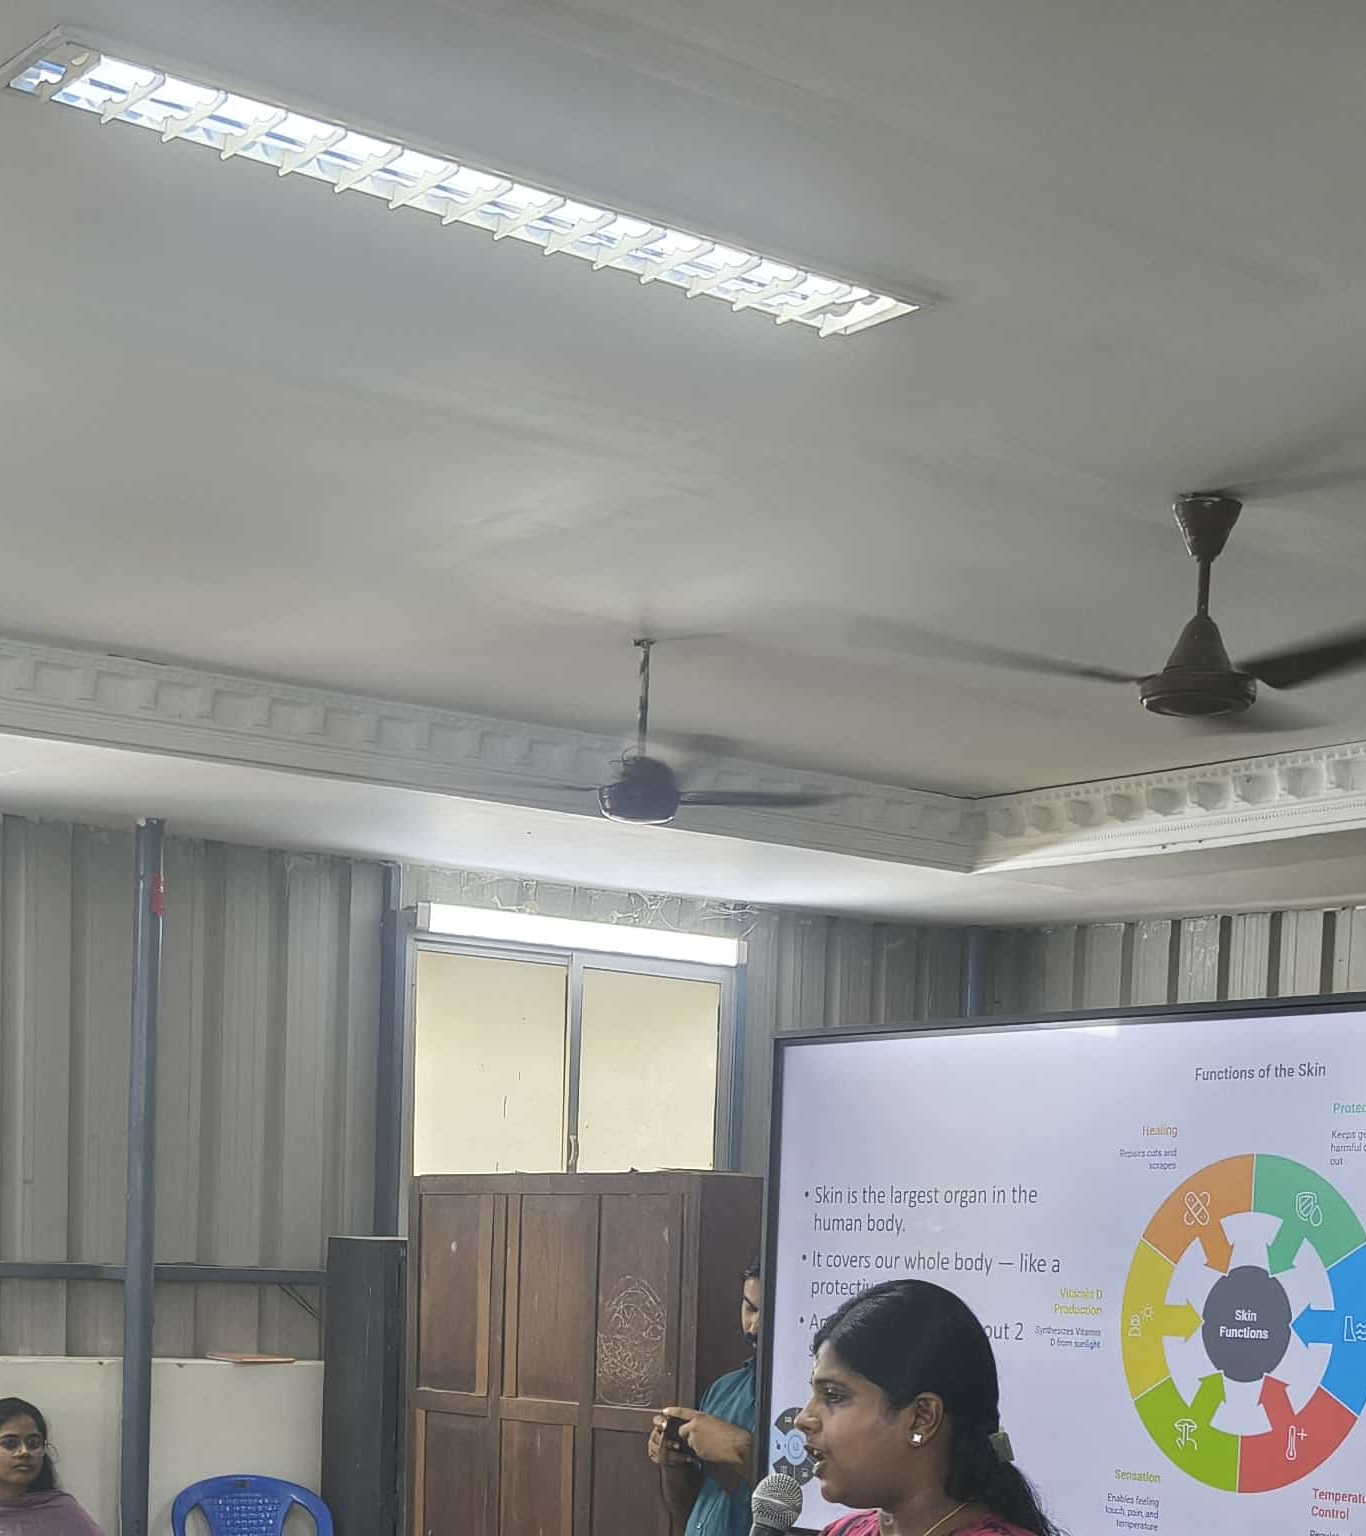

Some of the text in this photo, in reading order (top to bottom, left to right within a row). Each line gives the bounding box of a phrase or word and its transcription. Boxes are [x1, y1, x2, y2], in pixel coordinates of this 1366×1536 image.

[1194, 1061, 1326, 1080] Functions of the Skin
[1142, 1125, 1178, 1138] Healing
[1331, 1130, 1356, 1141] Keeps
[1163, 1148, 1178, 1157] and
[1330, 1143, 1362, 1153] harmful
[1330, 1158, 1344, 1166] out
[815, 1183, 1038, 1208] Skin is the largest organ in the
[814, 1212, 906, 1236] human body.
[812, 1249, 822, 1268] It
[826, 1253, 871, 1269] covers
[875, 1255, 900, 1270] our
[904, 1249, 950, 1271] whole
[954, 1251, 993, 1277] body
[1019, 1252, 1047, 1273] like
[1051, 1258, 1060, 1273] a
[1053, 1303, 1103, 1316] Production
[1234, 1309, 1257, 1322] Skin
[1014, 1321, 1024, 1341] 2
[1219, 1325, 1269, 1340] Functions
[1114, 1468, 1161, 1484] Sensation
[1311, 1505, 1350, 1521] Control
